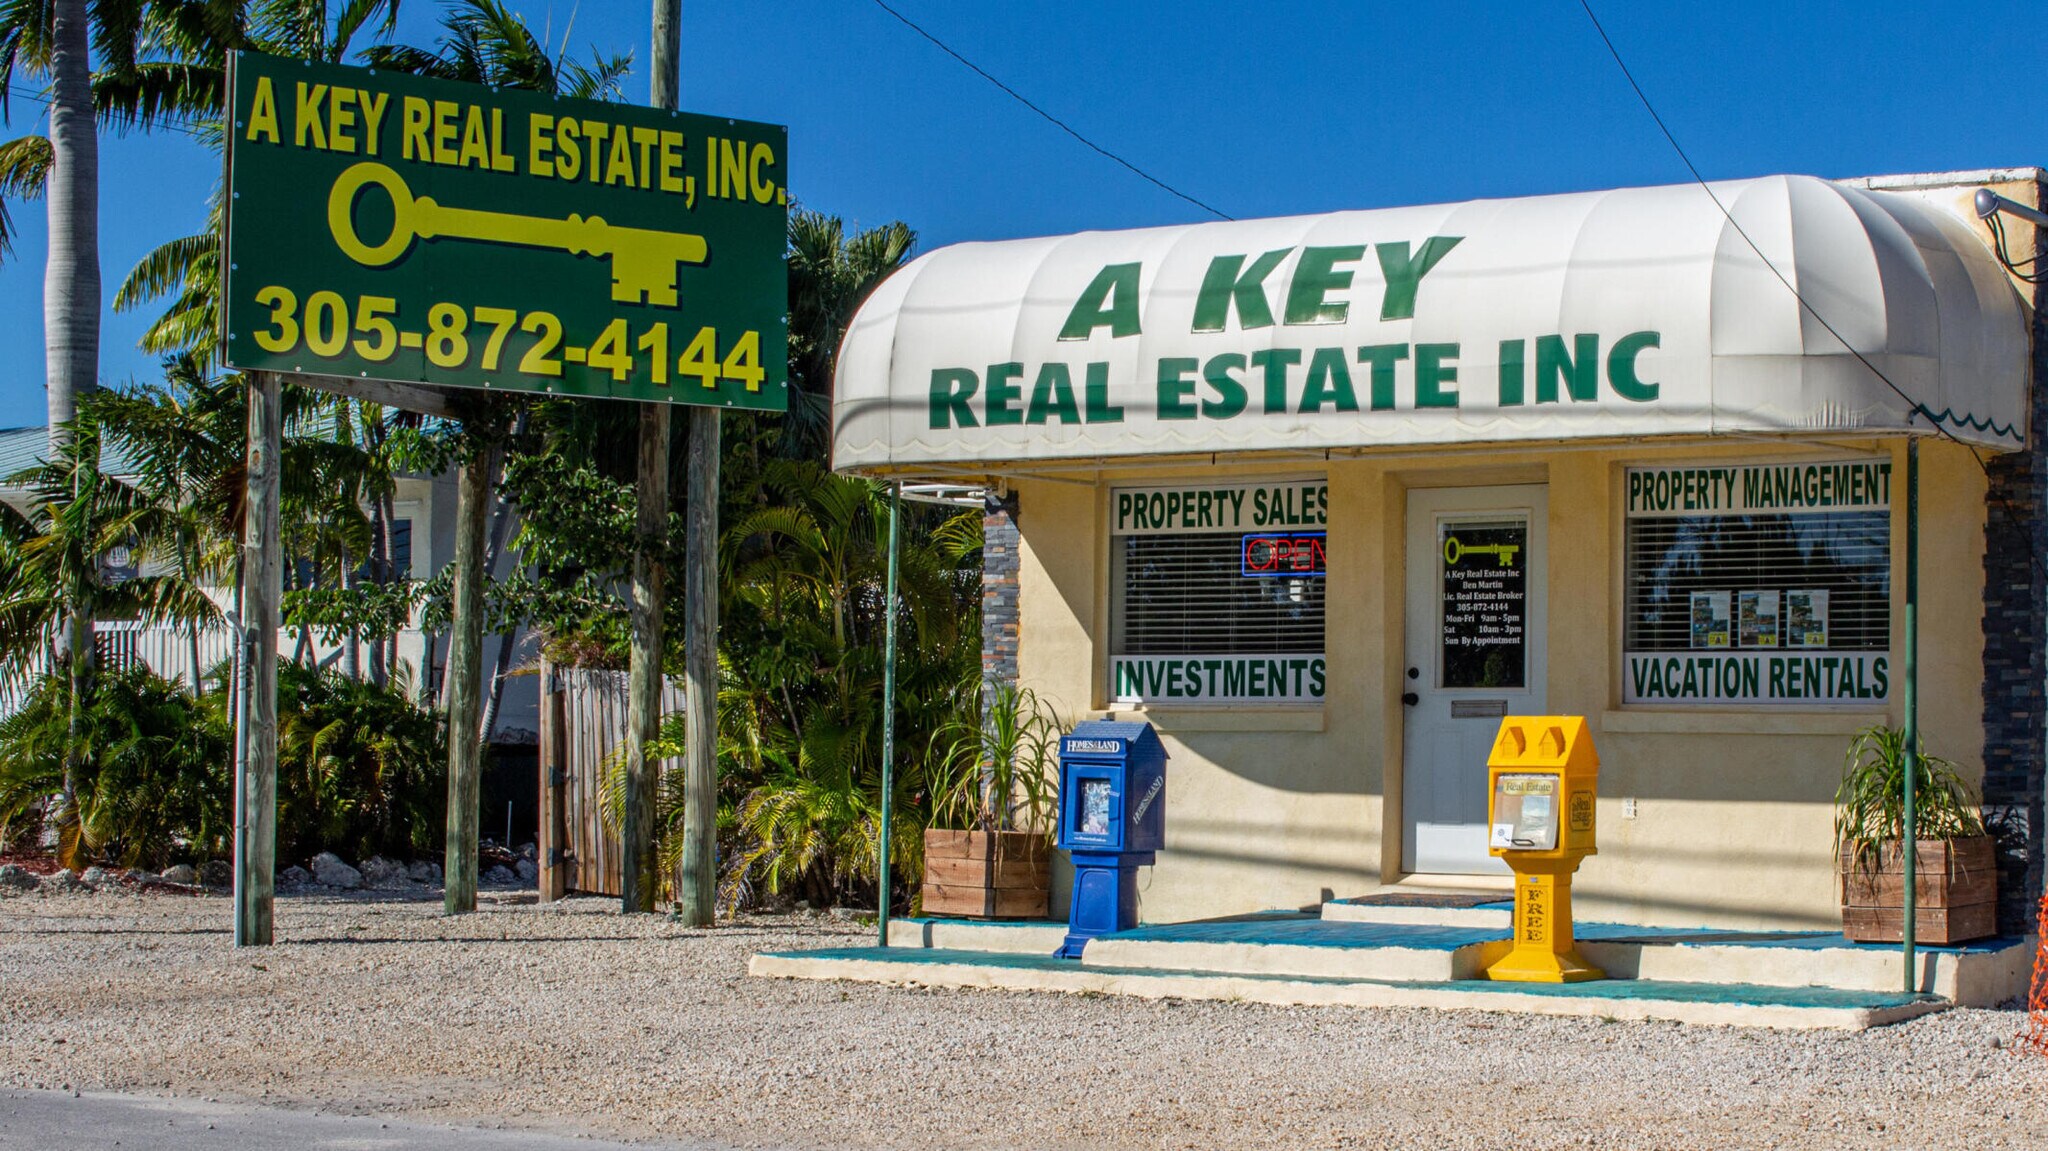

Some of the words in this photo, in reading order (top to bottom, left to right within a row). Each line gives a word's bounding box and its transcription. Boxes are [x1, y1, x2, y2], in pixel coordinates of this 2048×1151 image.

[247, 76, 280, 144] A
[295, 81, 389, 156] KEY
[402, 96, 516, 173] REAL
[529, 112, 696, 209] ESTATE,
[706, 136, 787, 206] INC.
[1056, 261, 1142, 341] A
[1191, 235, 1466, 334] KEY
[252, 285, 766, 392] 305-872-4144
[929, 360, 1125, 430] REAL
[1157, 341, 1460, 421] ESTATE
[1498, 330, 1661, 407] INC
[1629, 468, 1737, 512] PROPERTY
[1743, 463, 1892, 509] MANAGEMENT
[1118, 489, 1246, 530] PROPERTY
[1253, 485, 1328, 527] SALES
[1246, 538, 1327, 571] OPEN
[1445, 570, 1451, 579] A
[1452, 570, 1466, 580] Key
[1466, 569, 1483, 578] Real
[1484, 569, 1507, 578] Estate
[1507, 568, 1520, 577] Inc
[1462, 581, 1477, 589] Ben
[1478, 581, 1503, 589] Martin
[1456, 592, 1473, 600] Real
[1473, 591, 1497, 600] Estate
[1497, 591, 1523, 600] Broker
[1456, 602, 1509, 611] 305-872-4144
[1444, 625, 1456, 634] Sat
[1479, 624, 1500, 633] 10am
[1504, 624, 1522, 635] 3pm
[1445, 614, 1475, 622] Mon-Fri
[1480, 613, 1497, 622] 9am
[1502, 613, 1520, 624] 5pm
[1445, 636, 1459, 645] Sun
[1461, 636, 1471, 647] By
[1472, 635, 1520, 646] Appointment
[1116, 658, 1326, 698] INVESTMENTS
[1631, 657, 1760, 698] VACATION
[1769, 656, 1888, 699] RENTALS
[1506, 782, 1524, 791] Real
[1526, 782, 1551, 791] Estate
